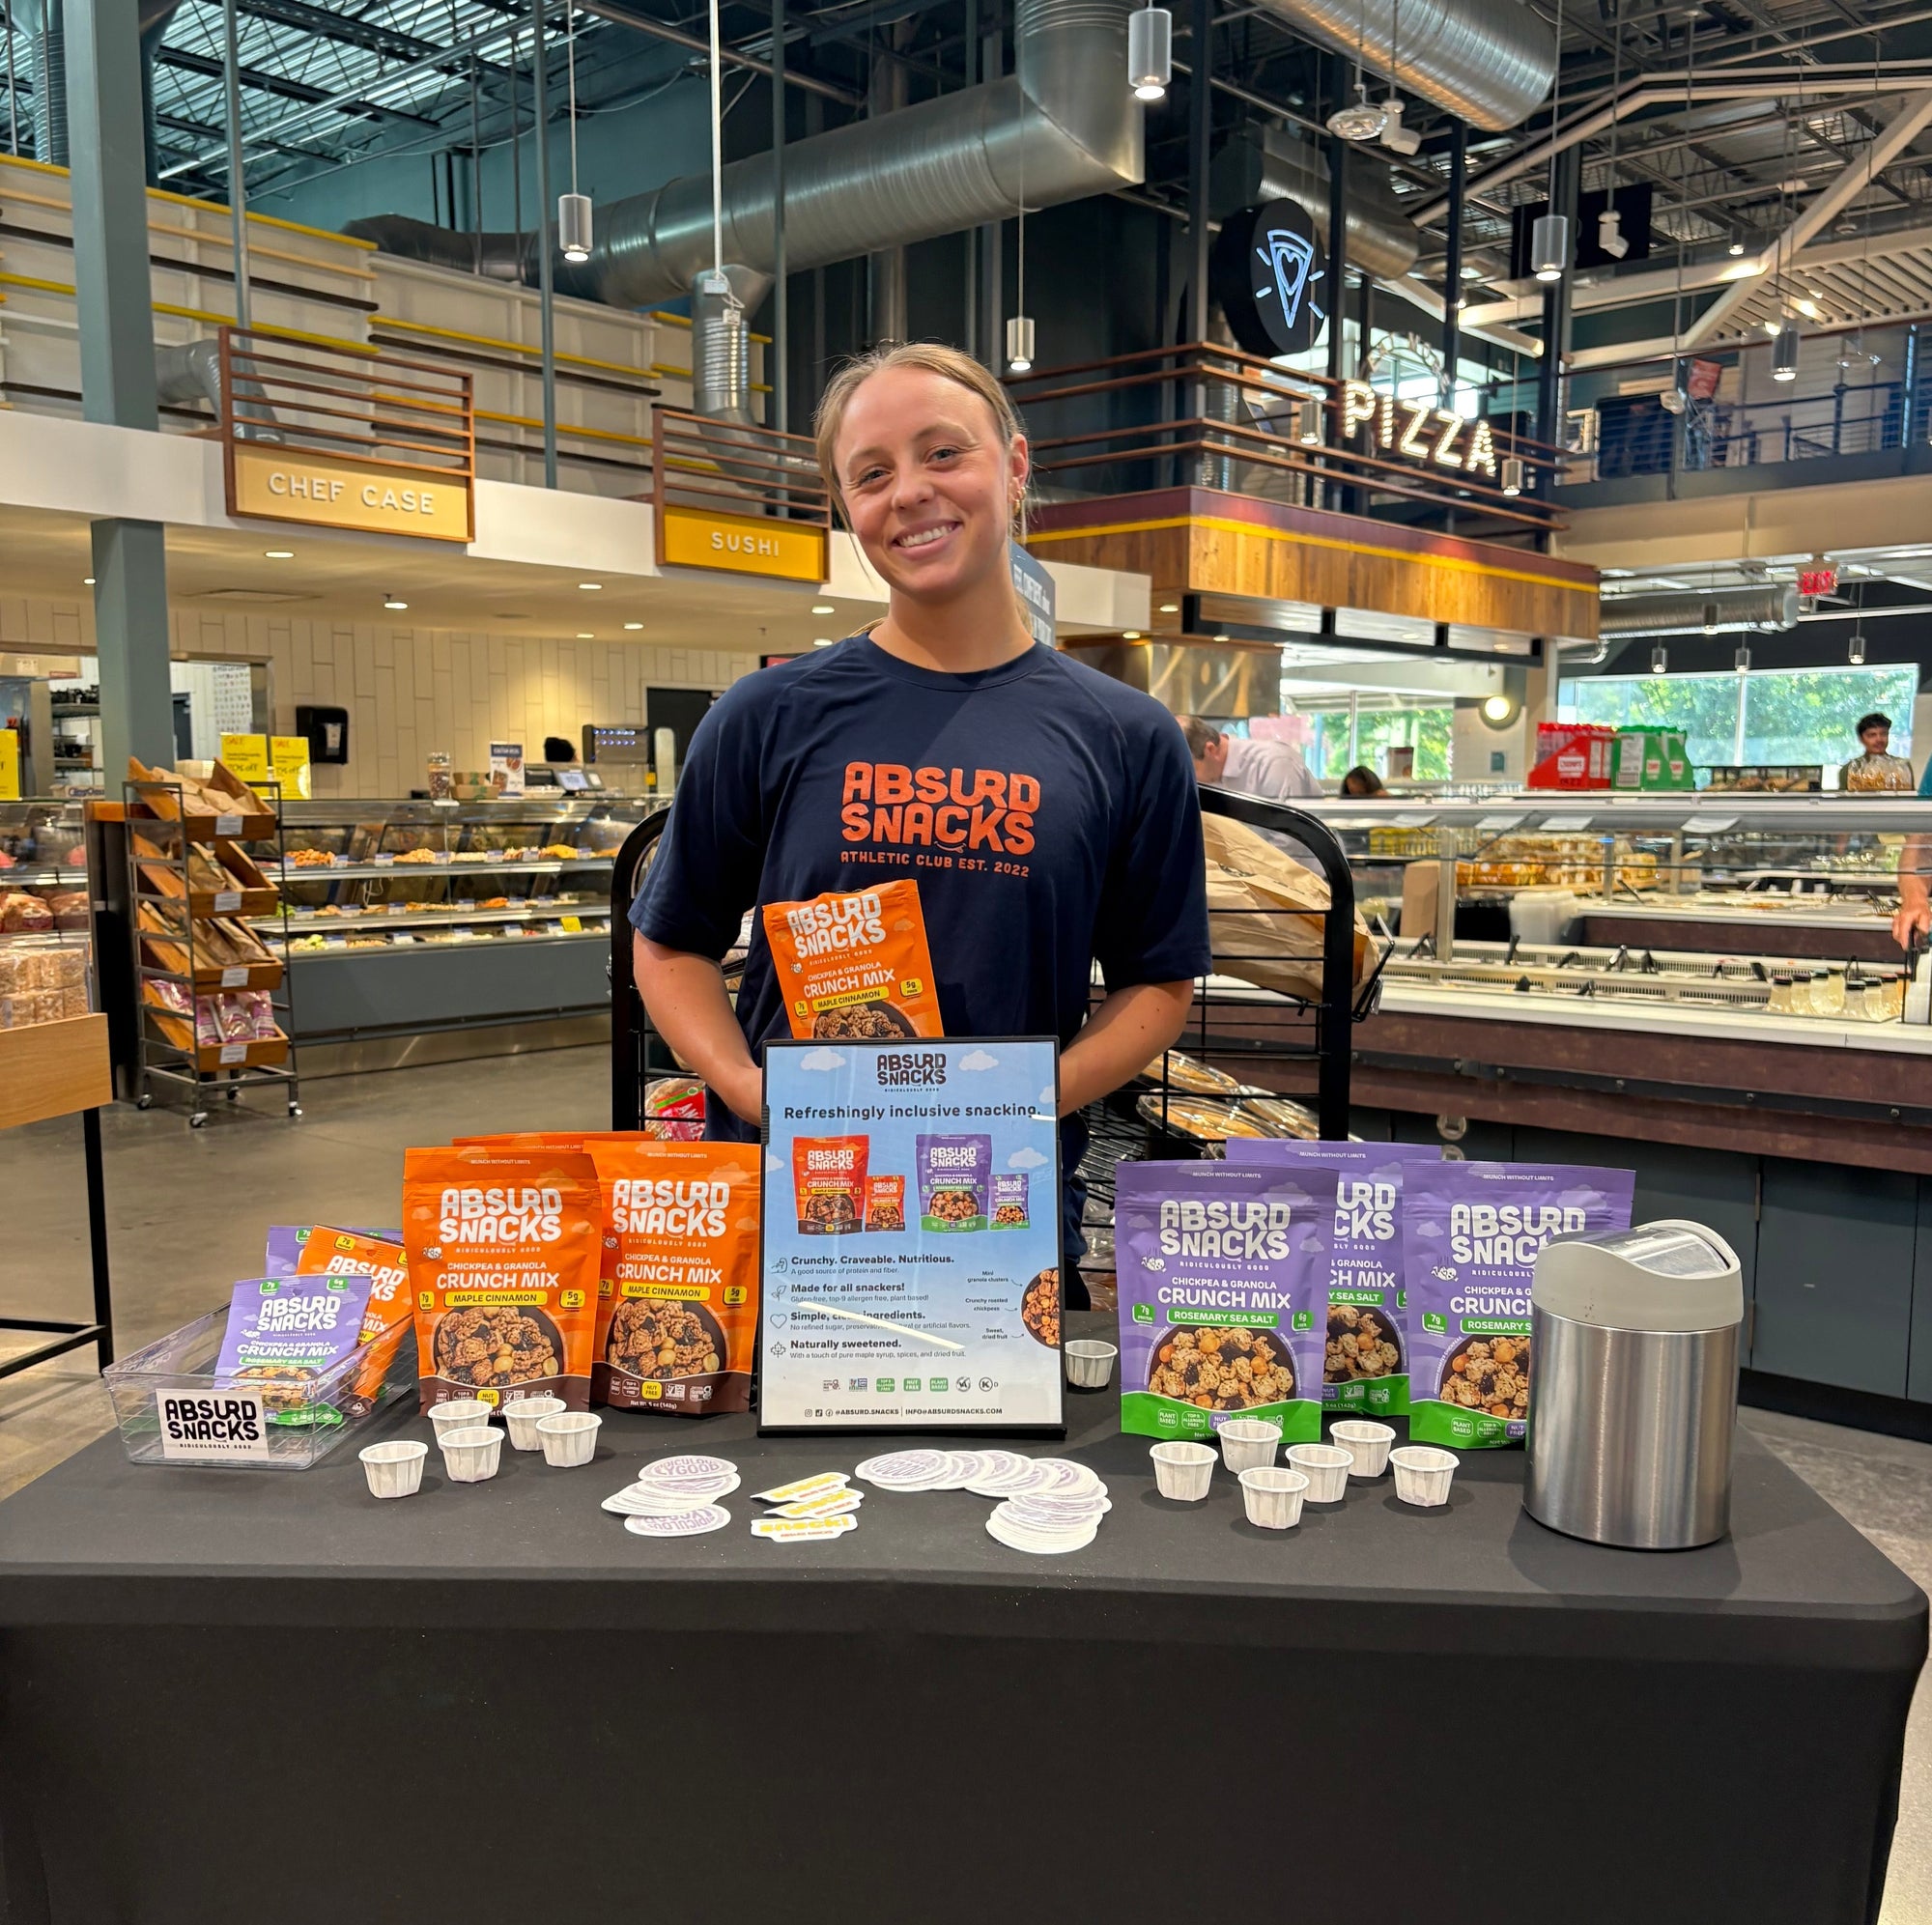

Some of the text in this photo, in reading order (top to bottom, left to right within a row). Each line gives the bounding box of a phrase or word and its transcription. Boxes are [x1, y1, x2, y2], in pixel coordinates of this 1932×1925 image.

[1344, 379, 1497, 477] PIZZA
[269, 472, 435, 515] CHEF CASE
[711, 531, 780, 557] SUSHI
[841, 761, 1040, 814] ABSURD
[840, 802, 1036, 856] SNACKS
[840, 850, 1030, 878] ATHLETIC CLUB EST. 2022
[786, 893, 882, 939] ABSURD
[794, 919, 886, 959] SNACKS
[808, 961, 881, 981] CHICKPEA GRANOLA
[804, 968, 895, 998] CRUNCH MIX
[817, 990, 880, 1008] MAPLE CINNAMON
[877, 1053, 947, 1071] ABSURD
[877, 1068, 947, 1086] SNACKS
[784, 1103, 1040, 1120] Refreshingly inclusive snacking.
[808, 1149, 854, 1162] ABSURD
[930, 1147, 977, 1159] ABSURD
[930, 1156, 977, 1168] SNACKS
[808, 1159, 854, 1171] SNACKS
[612, 1179, 730, 1209] ABSURD
[1337, 1181, 1396, 1211] URD
[440, 1188, 563, 1220] ABSURD
[612, 1207, 726, 1237] SNACKS
[1160, 1200, 1292, 1231] ABSURD
[1334, 1208, 1395, 1240] CKS
[1450, 1203, 1586, 1238] ABSURD
[439, 1214, 562, 1243] SNACKS
[1160, 1228, 1290, 1260] SNACKS
[1450, 1234, 1549, 1265] SNAC
[447, 1262, 493, 1271] CHICKPEA
[503, 1261, 547, 1270] GRANOLA
[625, 1253, 660, 1262] CHICKPEA
[670, 1256, 711, 1265] GRANOLA
[791, 1254, 954, 1266] Crunchy. Craveable. Nutritious.
[1179, 1261, 1241, 1270] RIDICULOUSLY
[1337, 1260, 1382, 1269] GRANOLA
[437, 1272, 559, 1289] CRUNCH MIX
[615, 1263, 723, 1284] CRUNCH MIX
[1357, 1271, 1396, 1288] MIX
[628, 1286, 700, 1297] MAPLE CINNAMON
[791, 1283, 905, 1292] Made for all snackers!
[1172, 1277, 1219, 1288] CHICKPEA
[1231, 1280, 1277, 1289] GRANOLA
[1464, 1286, 1514, 1295] CHICKPEA
[453, 1294, 483, 1303] MAPLE
[568, 1291, 579, 1300] 5g
[731, 1288, 740, 1297] 5g
[1157, 1287, 1291, 1310] CRUNCH MIX
[1336, 1292, 1380, 1302] SEA SALT
[259, 1295, 341, 1319] ABSURD
[1141, 1305, 1150, 1316] 7g
[256, 1312, 337, 1332] SNACKS
[790, 1312, 830, 1322] Simple,
[1174, 1311, 1274, 1324] ROSEMARY SEA SALT
[1298, 1313, 1307, 1323] 6g
[1431, 1314, 1441, 1325] 7g
[1467, 1320, 1525, 1331] ROSEMARY
[237, 1345, 339, 1357] CRUNCH MIX
[790, 1339, 901, 1350] Naturally sweetened.
[165, 1399, 258, 1422] ABSURD
[168, 1419, 260, 1441] SNACKS
